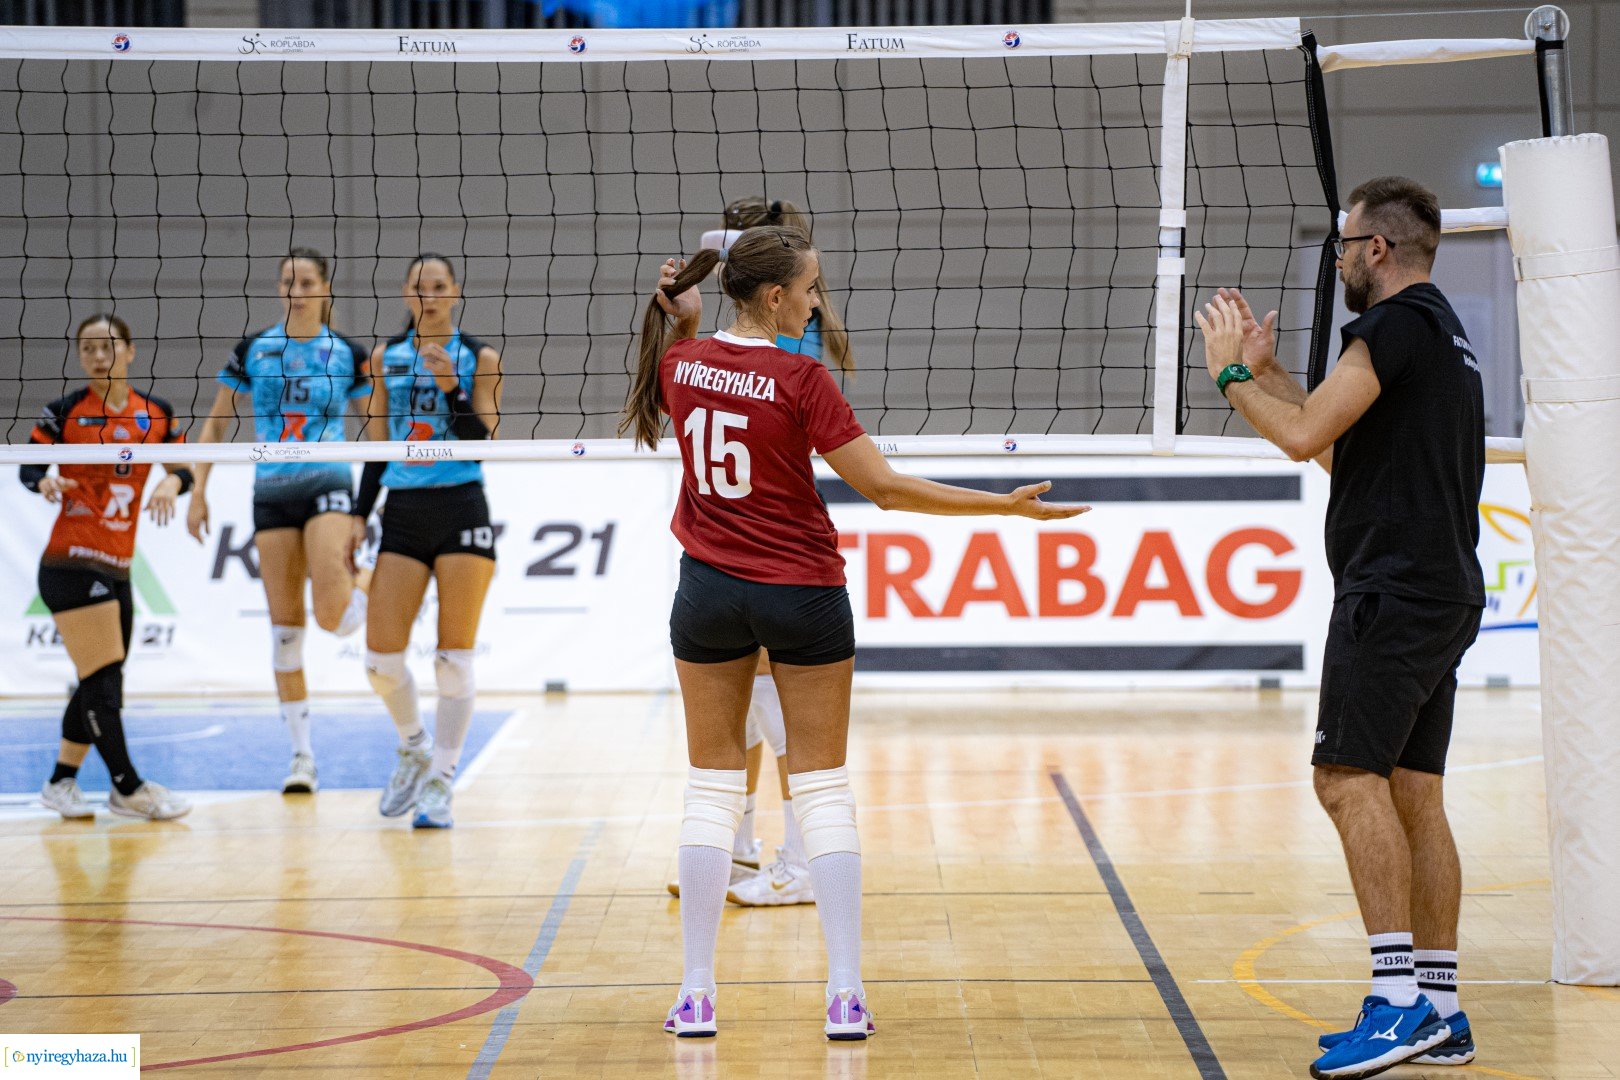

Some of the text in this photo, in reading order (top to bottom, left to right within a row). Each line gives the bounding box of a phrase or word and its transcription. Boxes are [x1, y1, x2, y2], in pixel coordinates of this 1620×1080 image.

[673, 361, 775, 402] NYÍREGYHÁZA
[684, 406, 753, 500] 15
[526, 522, 617, 577] 21
[838, 526, 1304, 621] RABAG
